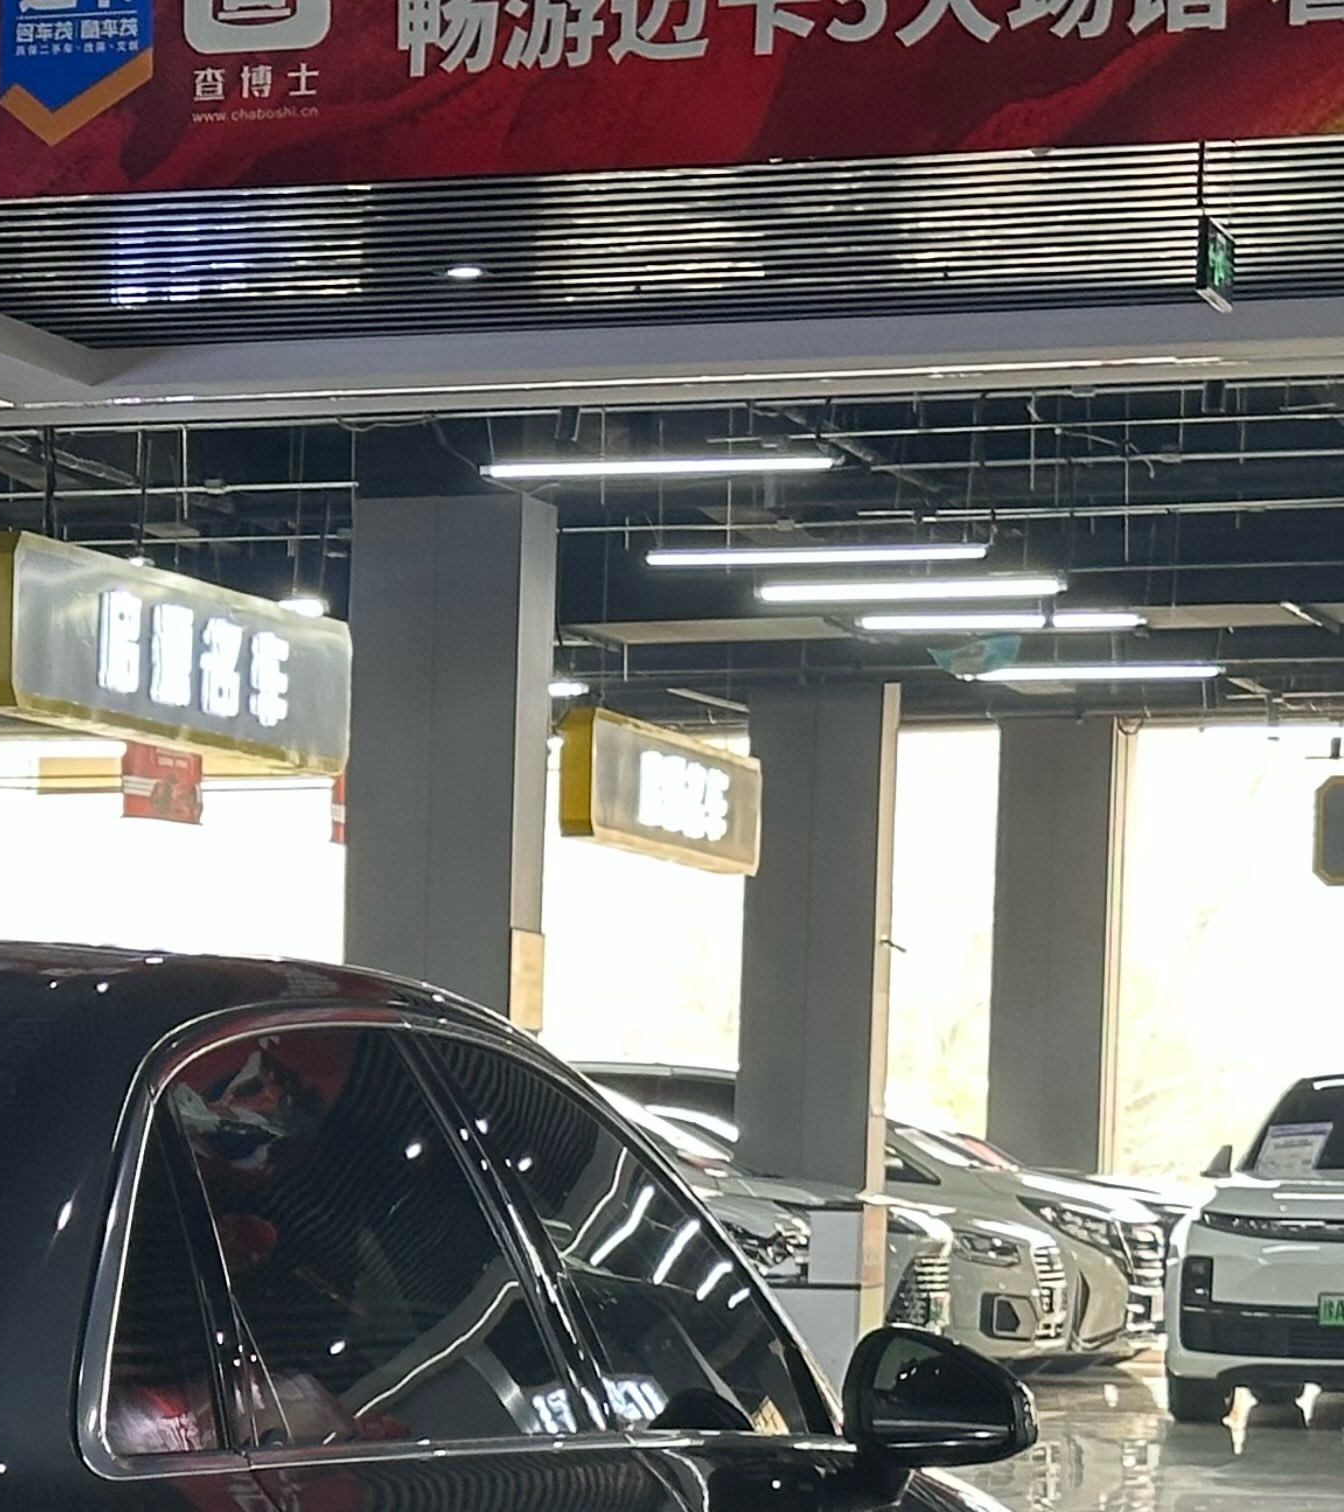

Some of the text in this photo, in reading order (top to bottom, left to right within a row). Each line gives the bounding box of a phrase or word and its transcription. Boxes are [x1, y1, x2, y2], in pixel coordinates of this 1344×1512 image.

[193, 62, 320, 101] 查博士
[192, 106, 319, 122] www.chaboshi.cn
